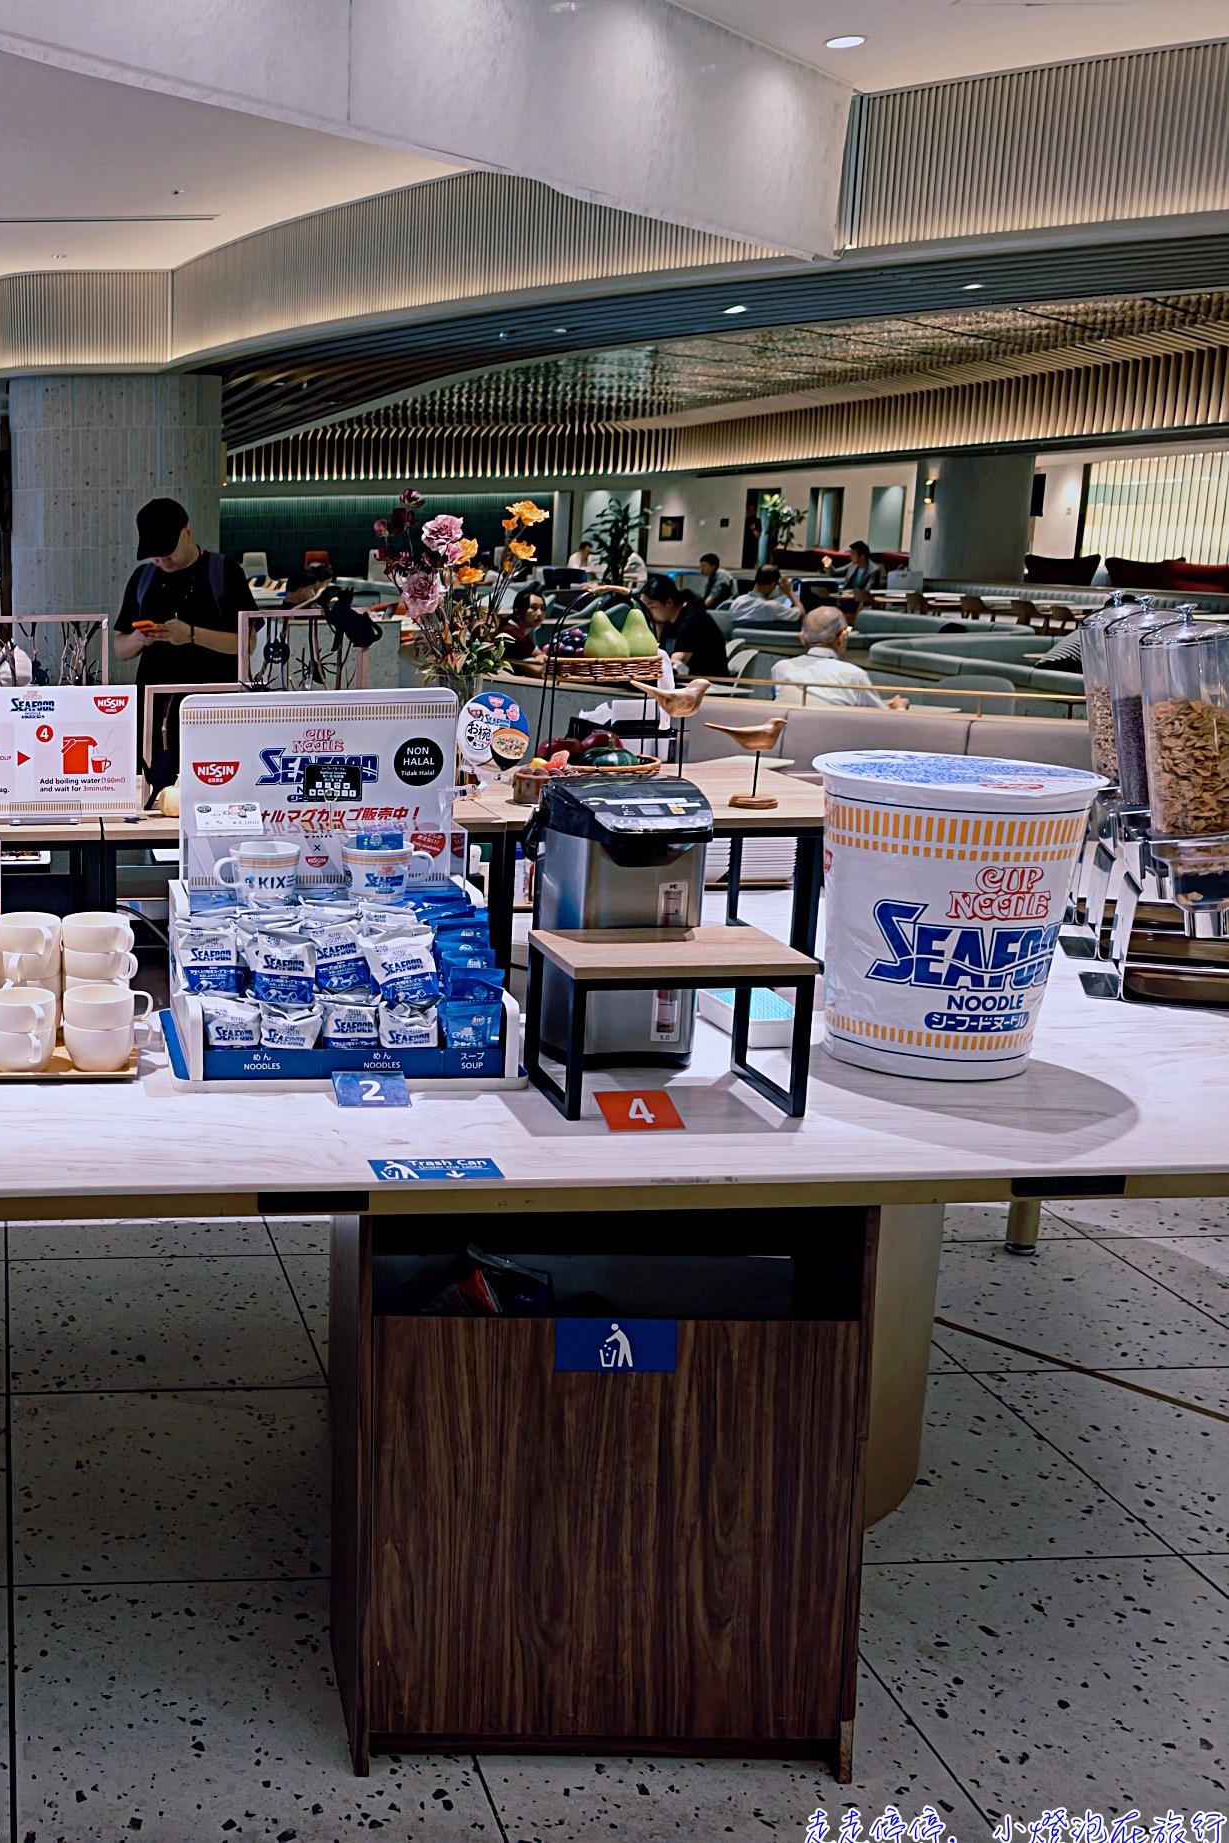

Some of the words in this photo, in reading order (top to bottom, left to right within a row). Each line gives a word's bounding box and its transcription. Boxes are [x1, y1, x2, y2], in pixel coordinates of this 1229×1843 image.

[10, 698, 55, 713] SEAFOOD
[97, 697, 125, 709] NISSIN
[40, 728, 49, 739] 4
[303, 729, 336, 742] CUP
[467, 721, 491, 741] お椀
[406, 746, 429, 755] NON
[403, 756, 435, 766] HALAL
[197, 763, 234, 778] NISSIN
[261, 806, 420, 823] ナルマグカップ販売中！
[258, 876, 286, 889] KIX
[975, 866, 1044, 893] CUP
[945, 890, 1051, 921] NOODLE
[865, 899, 1062, 991] SEAFOO
[191, 948, 231, 961] SEAFOOD
[262, 955, 305, 972] SEAFOOD
[381, 958, 424, 978] SEAFOOD
[947, 994, 1025, 1011] NOODLE
[333, 1019, 373, 1034] SEAFOOD
[931, 1013, 1028, 1030] シーフードヌードル
[388, 1030, 430, 1045] SEAFOOD
[460, 1052, 485, 1060] スープ
[243, 1062, 281, 1070] NOODLES
[363, 1061, 401, 1069] NOODLES
[359, 1080, 386, 1101] 2
[628, 1098, 655, 1123] 4
